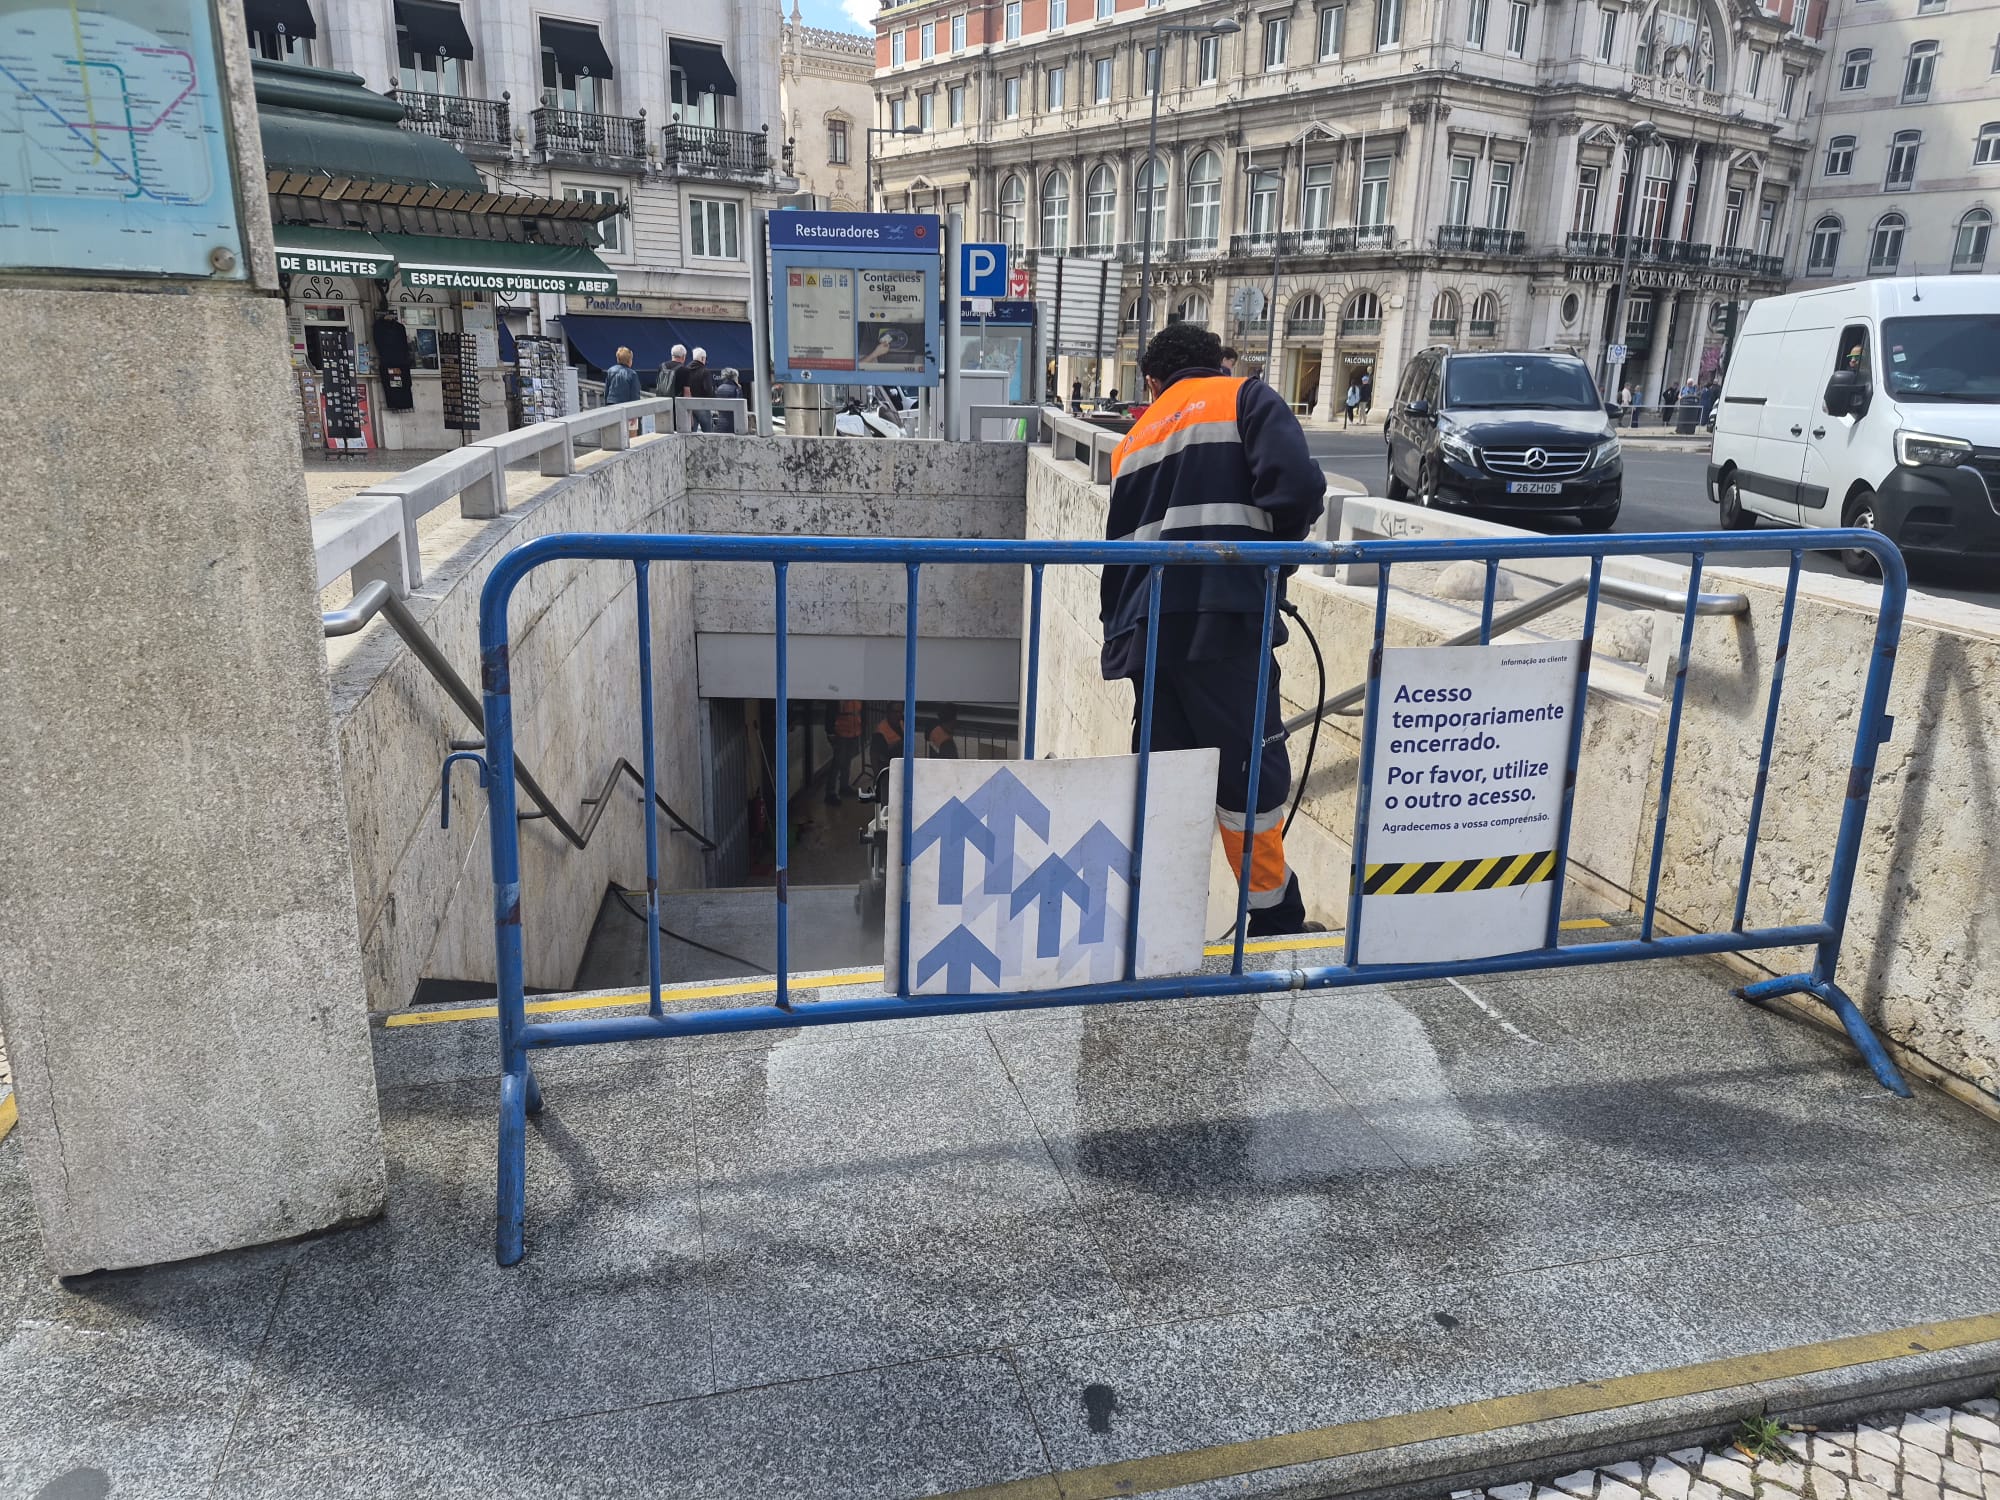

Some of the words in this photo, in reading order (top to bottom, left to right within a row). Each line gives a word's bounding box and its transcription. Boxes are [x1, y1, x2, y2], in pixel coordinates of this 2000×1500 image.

[795, 223, 880, 239] Restauradores
[280, 256, 301, 270] DE
[306, 258, 377, 275] BILHETES
[969, 249, 996, 292] P
[1570, 265, 1621, 283] HOTEL
[410, 272, 504, 289] ESPETÁCULOS
[507, 276, 566, 291] PÚBLICOS
[577, 280, 609, 293] ABEP
[863, 272, 921, 283] Contactless
[1136, 269, 1208, 287] PALACE
[876, 283, 896, 294] siga
[1501, 658, 1537, 666] Informação
[1547, 655, 1568, 663] cliente
[1394, 684, 1472, 703] Acesso
[1392, 703, 1564, 732] temporariamente
[1390, 732, 1500, 753] encerrado.
[1387, 766, 1424, 785] Por
[1429, 765, 1487, 784] favor,
[1493, 759, 1549, 780] utilize
[1385, 796, 1399, 809] o
[1404, 791, 1462, 809] outro
[1467, 788, 1536, 806] acesso.
[1382, 822, 1451, 834] Agradecemos
[1454, 822, 1459, 830] a
[1462, 820, 1489, 829] vossa
[1490, 813, 1550, 827] compreensão.
